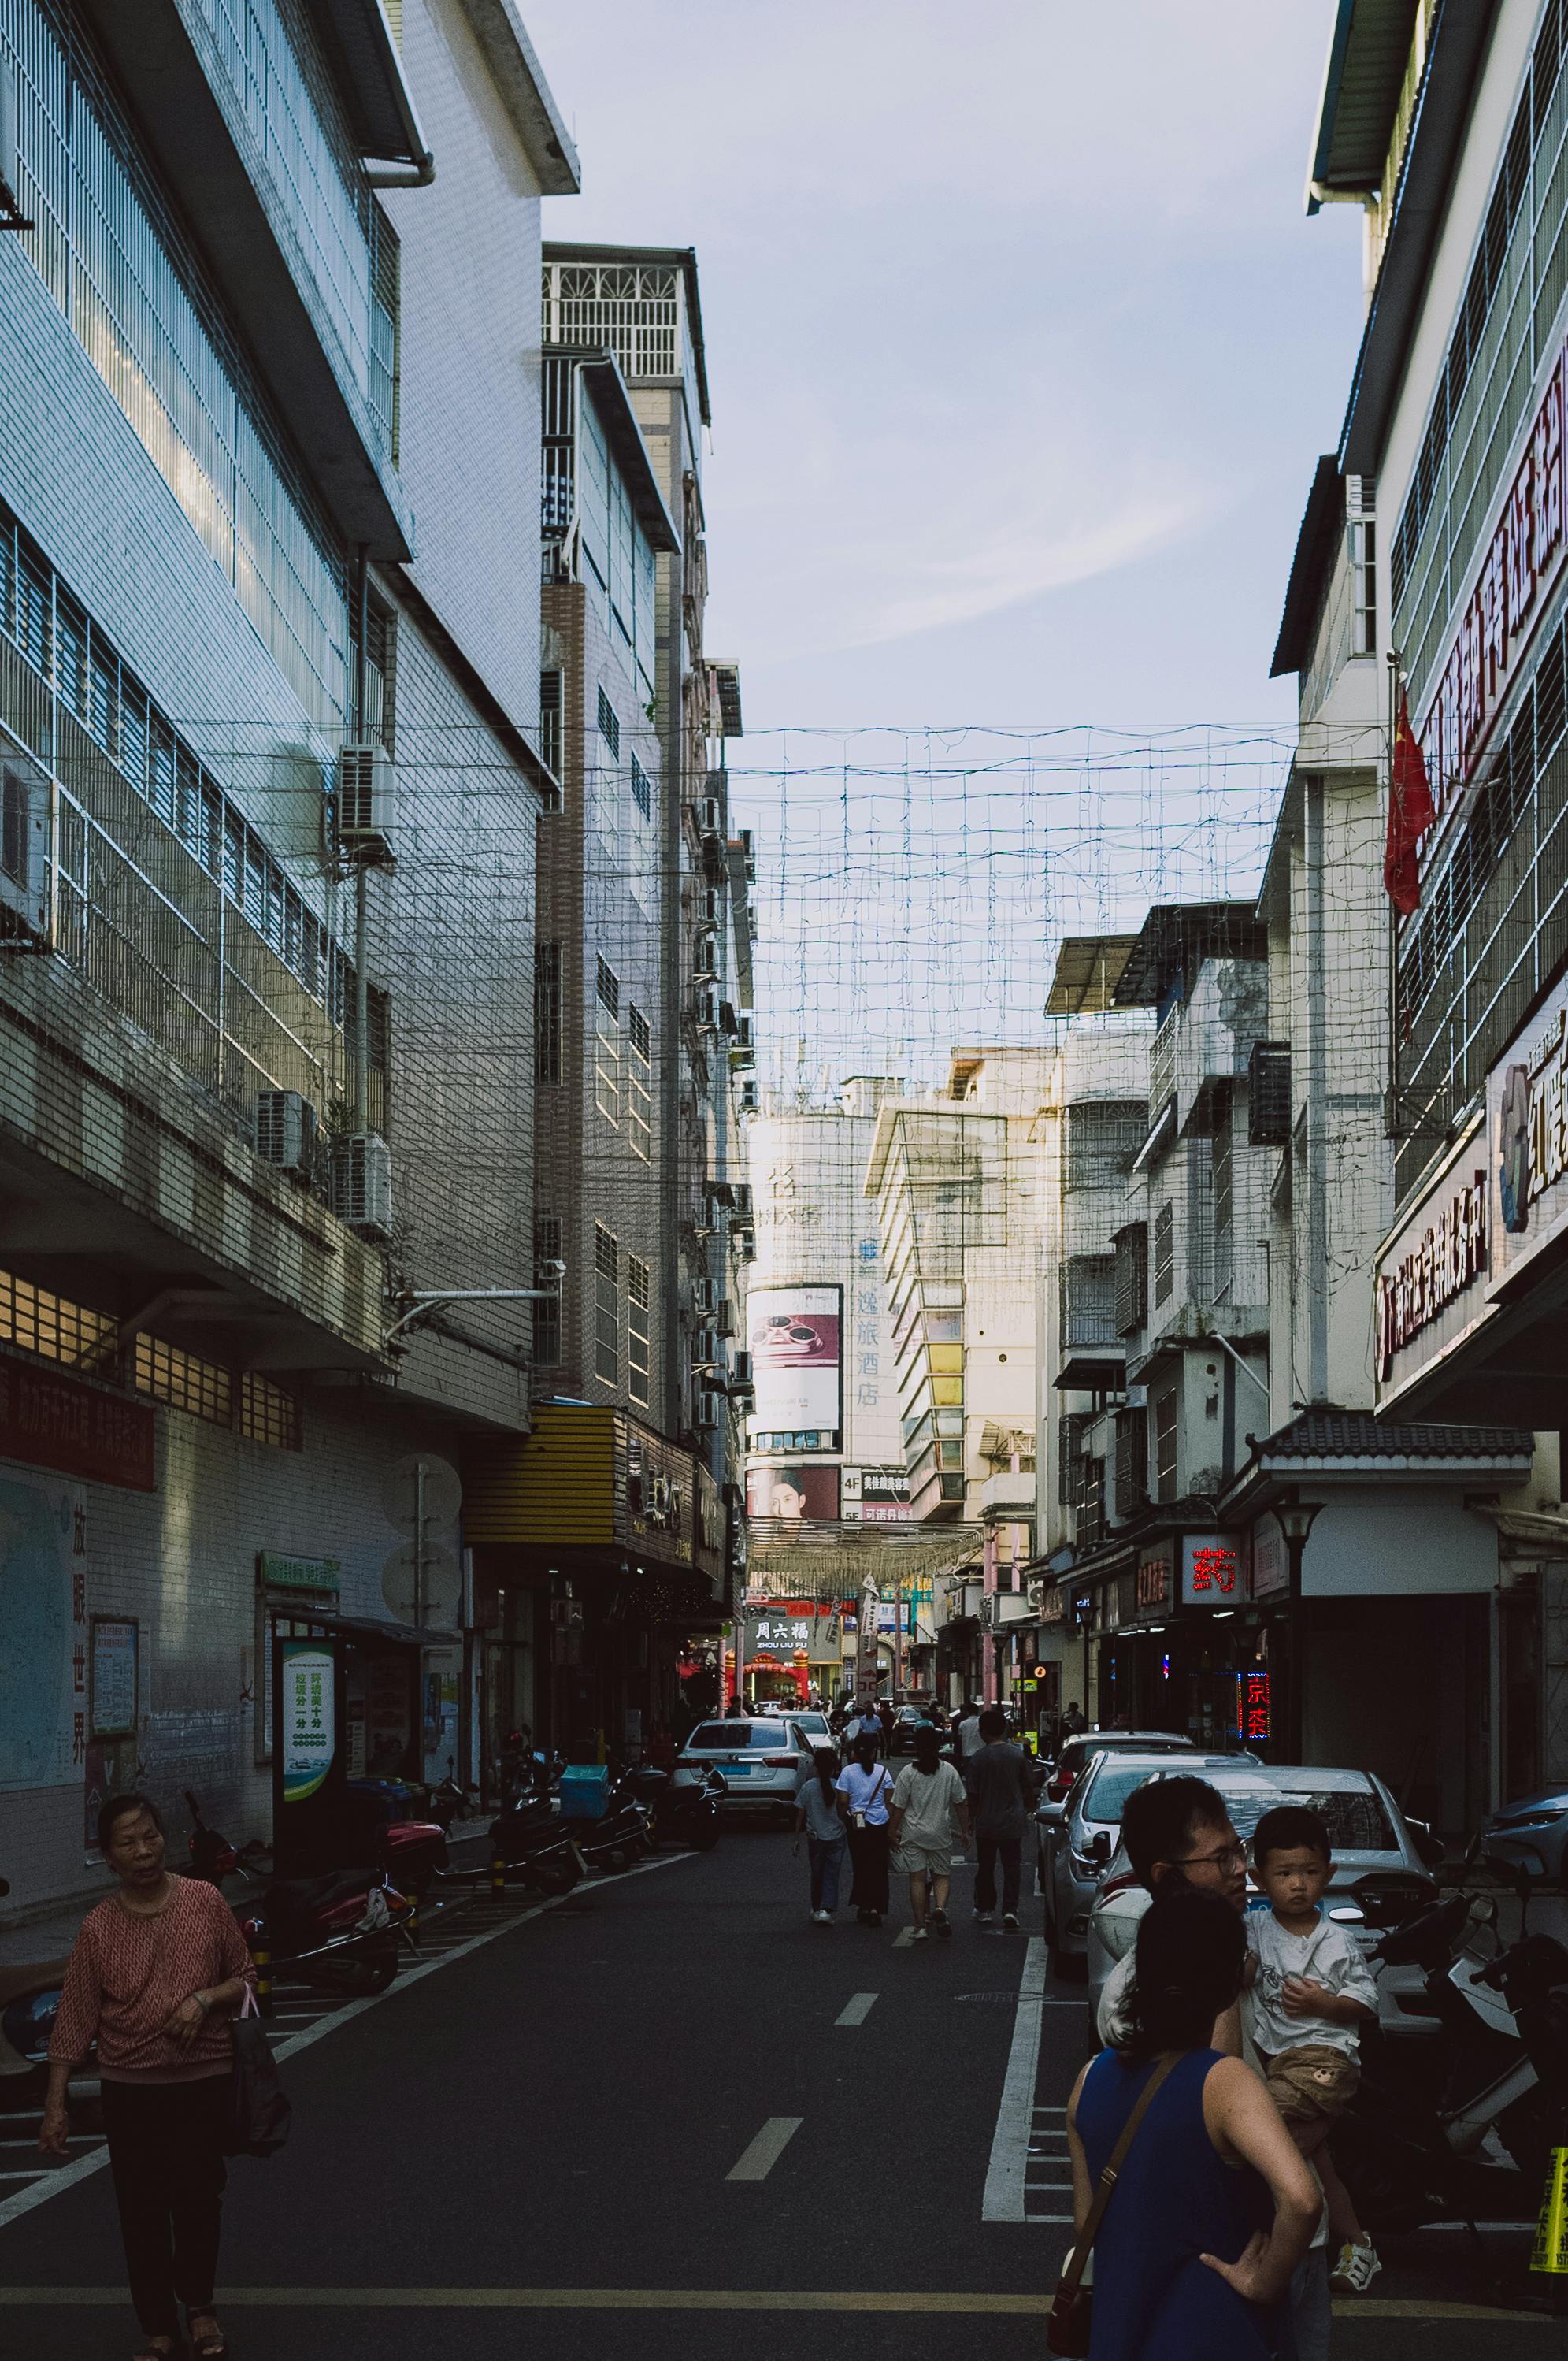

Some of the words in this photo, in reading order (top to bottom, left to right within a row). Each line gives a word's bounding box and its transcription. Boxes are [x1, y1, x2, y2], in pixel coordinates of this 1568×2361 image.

[1484, 530, 1503, 662] 平等
[1507, 459, 1530, 635] 公正
[1536, 381, 1561, 570] 法治
[1528, 1016, 1568, 1204] 红暖
[844, 1477, 859, 1489] 4F
[1192, 1546, 1236, 1592] 药
[755, 1621, 809, 1640] 周六福
[295, 1672, 307, 1729] 垃圾分一分
[311, 1672, 322, 1728] 环境美十分
